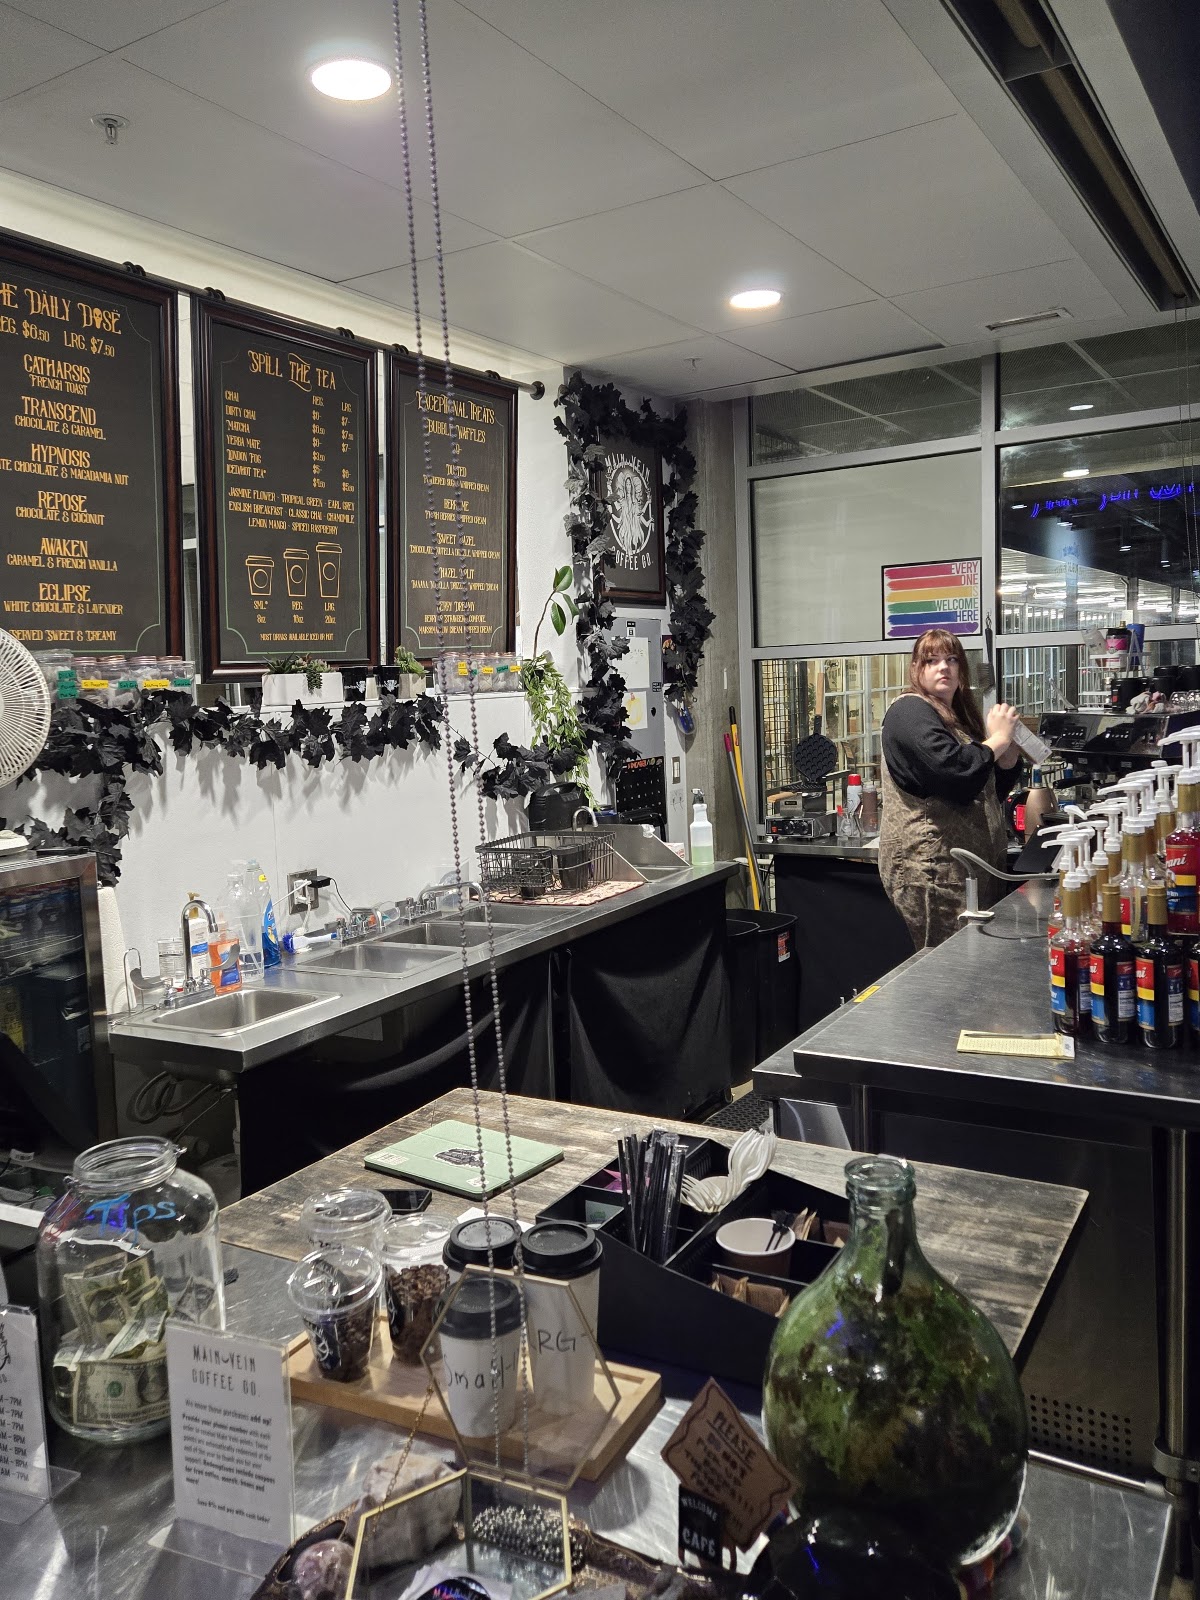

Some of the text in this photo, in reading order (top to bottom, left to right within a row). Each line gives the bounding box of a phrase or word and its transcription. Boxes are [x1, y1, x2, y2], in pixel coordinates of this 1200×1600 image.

[0, 283, 18, 308] HE
[22, 320, 50, 342] $6.50
[64, 331, 87, 350] LRG.
[90, 336, 115, 357] $7.50
[23, 354, 91, 384] CATHARSIS
[288, 354, 312, 389] THE
[316, 368, 336, 390] TEA
[29, 374, 88, 395] FRENCH TOAST
[225, 390, 239, 402] CHAI
[21, 395, 96, 426] TRANSCEND
[225, 405, 242, 417] DIRTY
[243, 409, 256, 420] CHAI
[15, 414, 106, 440] CHOCOLATE & CARAMEL
[226, 420, 250, 433] MATCHA
[456, 425, 486, 443] WAFFLES
[226, 435, 244, 447] YERBA
[246, 439, 260, 450] MATE
[31, 443, 90, 468] HYPNOSIS
[14, 461, 58, 477] CHOCOLATE
[61, 467, 68, 478] &
[70, 467, 112, 483] MACADAMIA
[114, 473, 129, 485] NUT
[446, 464, 467, 477] DUTED
[38, 490, 87, 513] REPOSE
[327, 499, 341, 510] EARL
[16, 506, 105, 526] CHOCOLATE & COCONUT
[311, 510, 322, 520] CHAI
[40, 538, 88, 557] AWAKEN
[7, 554, 118, 572] CARAMEL & FRENCH VANILLA
[952, 561, 978, 574] EVERY
[961, 573, 978, 586] ONE
[39, 582, 91, 602] ECLIPSE
[4, 601, 123, 615] WHITE CHOCOLATE & LAVENDER
[935, 598, 978, 611] WELCOME
[956, 610, 978, 621] HERE
[45, 629, 75, 641] SWEET
[77, 630, 84, 641] &
[86, 630, 116, 641] CREAMY
[86, 1192, 177, 1250] Tips
[193, 1345, 255, 1373] MAIN VEIN
[192, 1368, 234, 1391] COFFEE
[681, 1497, 717, 1522] WELCOME
